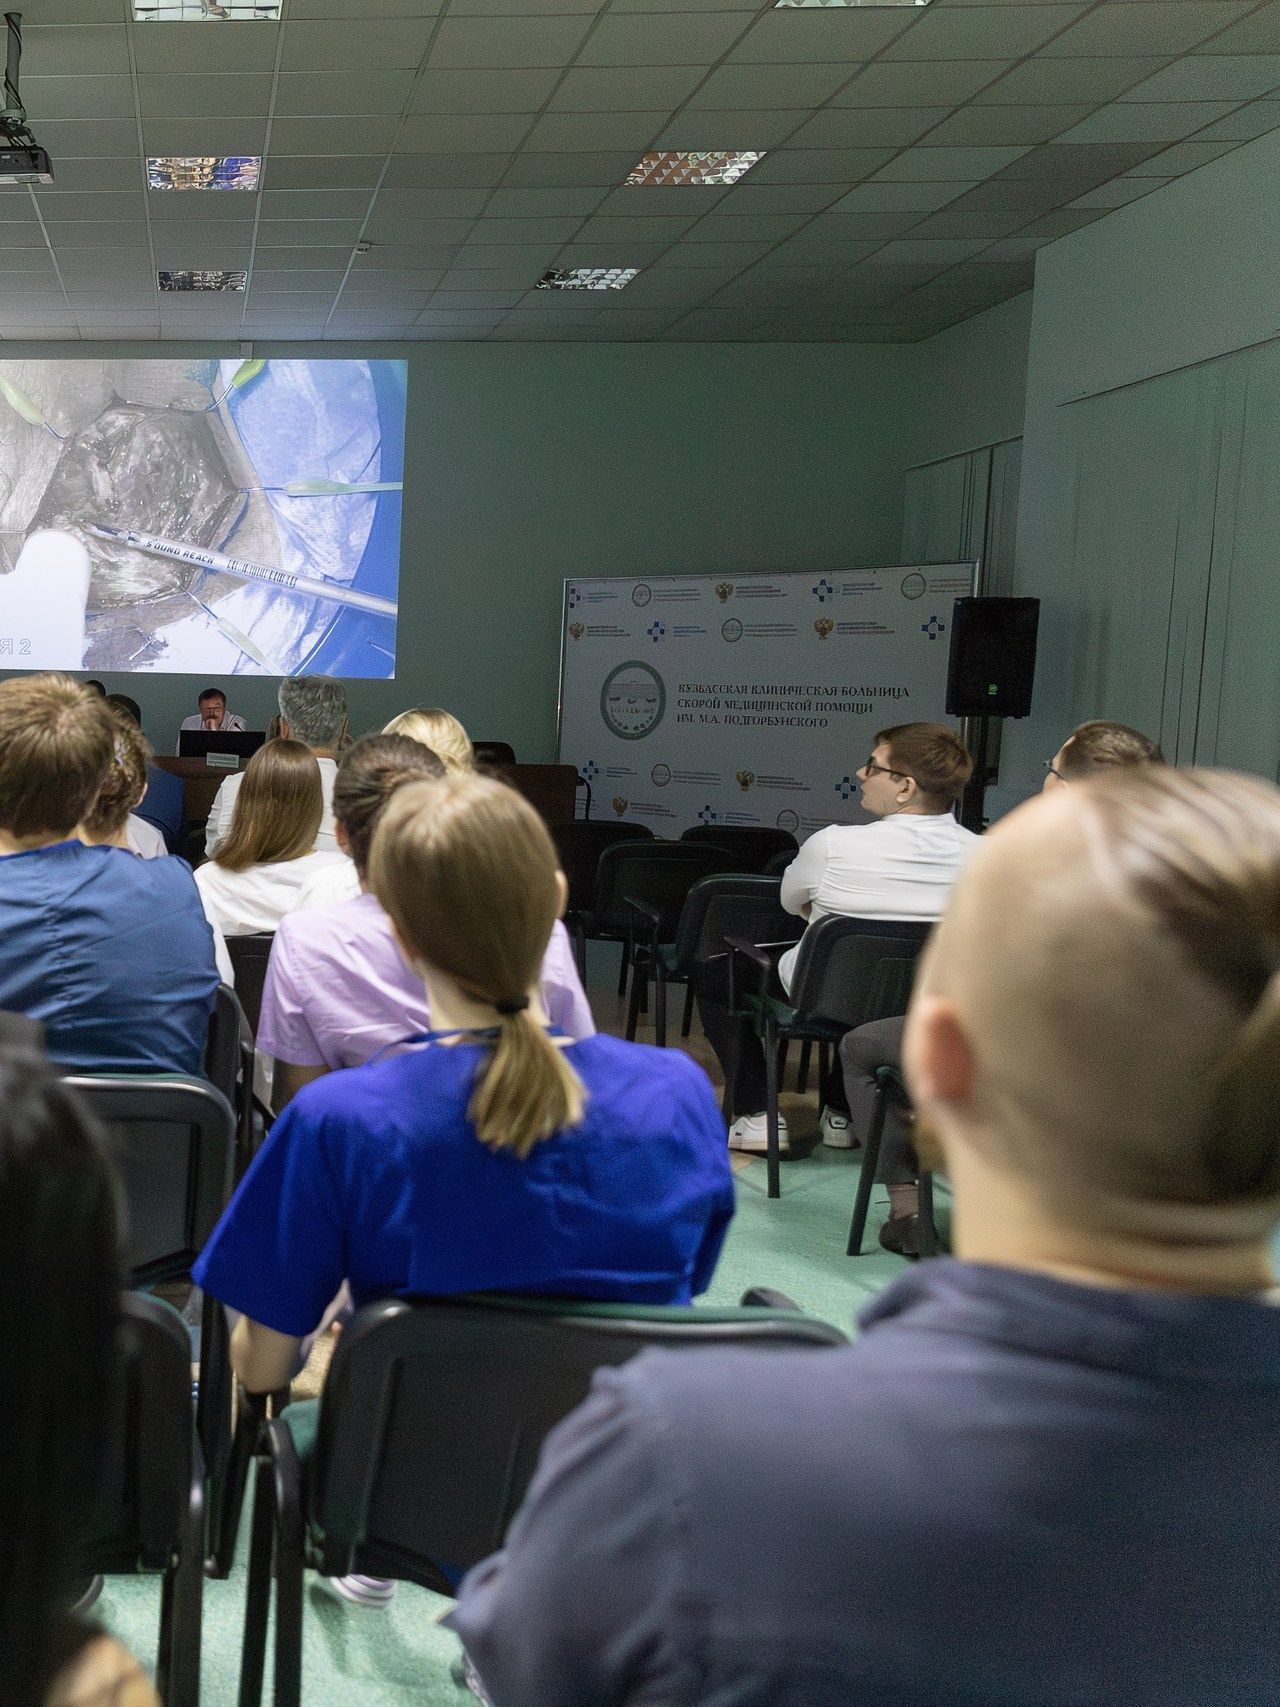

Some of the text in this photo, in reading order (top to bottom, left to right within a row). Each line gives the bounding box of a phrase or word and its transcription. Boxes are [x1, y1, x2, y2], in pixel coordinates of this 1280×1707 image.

[145, 540, 181, 556] SOUND
[18, 638, 31, 655] 2
[678, 683, 910, 700] КУЗБАССКАЯ КЛИНИЧЕСКАЯ БОЛЬНИЦА
[677, 697, 873, 714] СКОРОЙ МЕДИЦИНСКОЙ ПОМОЩИ
[677, 713, 696, 723] ИМ.
[724, 715, 828, 728] ПОДГОРБУНСКОГО
